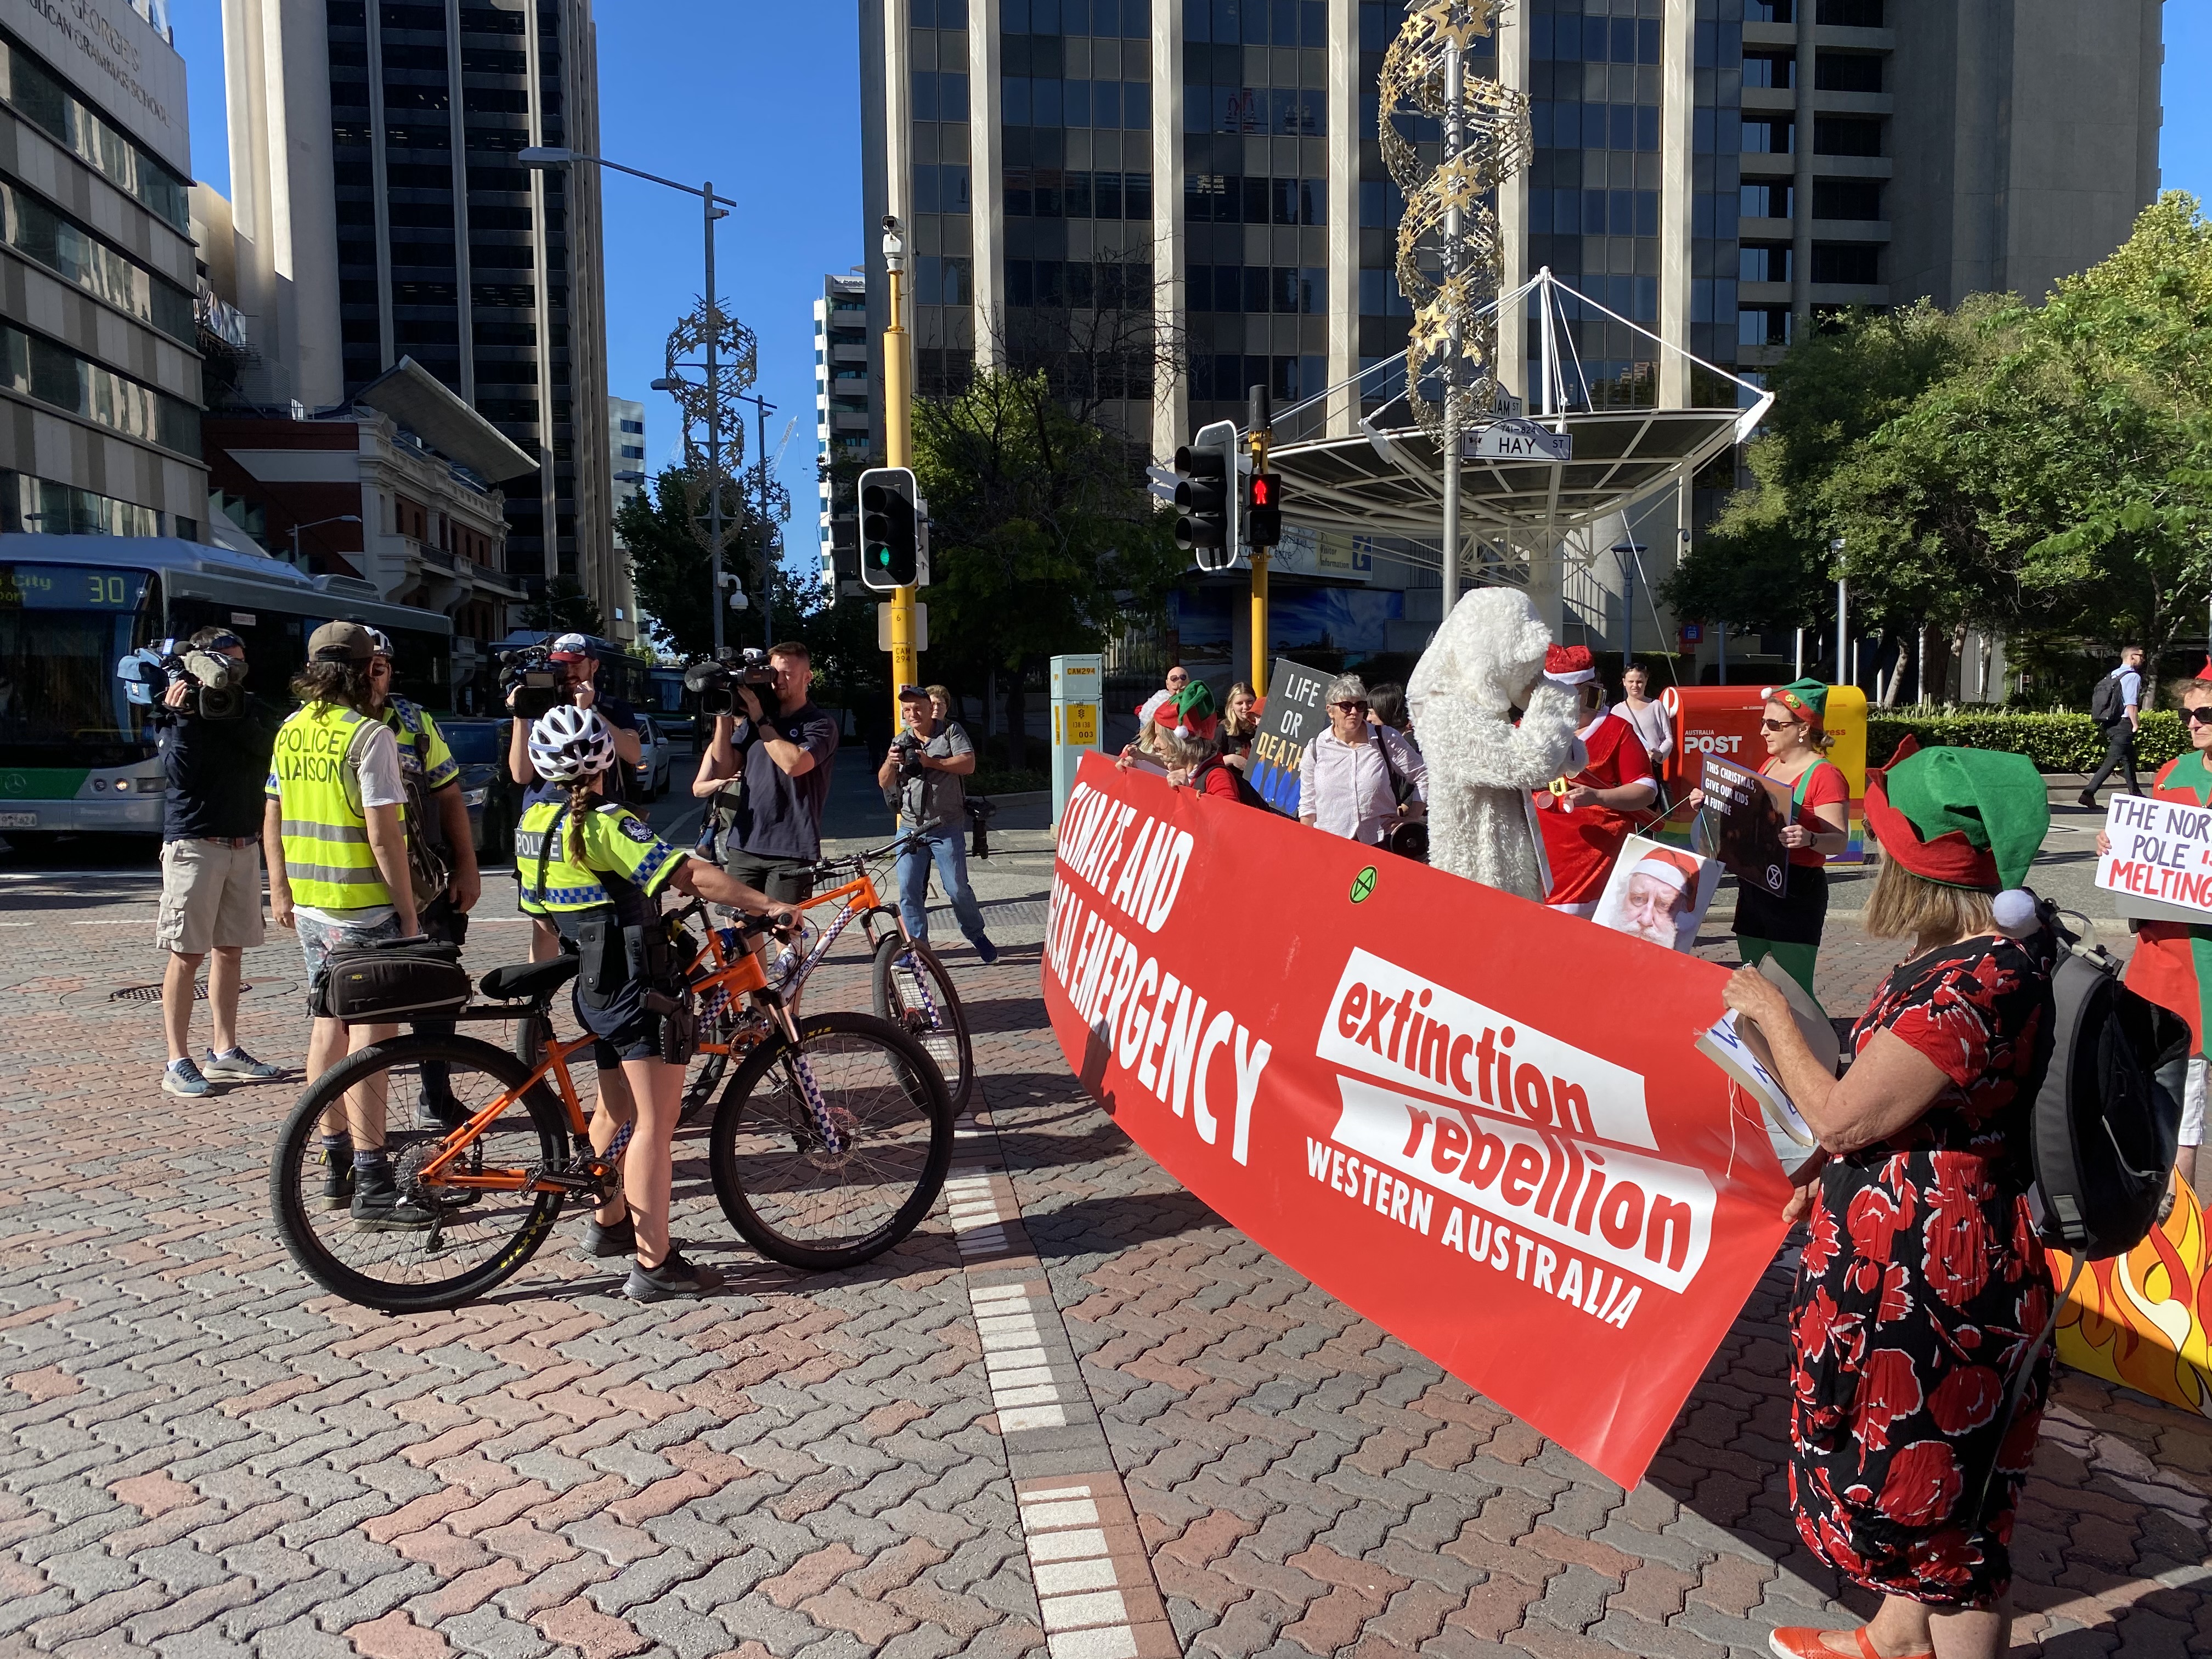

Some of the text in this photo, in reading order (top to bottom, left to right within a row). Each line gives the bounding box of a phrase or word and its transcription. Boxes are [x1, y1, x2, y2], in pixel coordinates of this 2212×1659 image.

[1513, 402, 1519, 411] ST
[1499, 437, 1564, 454] HAY ST
[10, 574, 125, 603] City 30
[1284, 674, 1321, 708] LIFE
[1280, 710, 1303, 738] OR
[278, 727, 347, 755] POLICE
[1684, 736, 1742, 754] POST
[276, 755, 343, 785] LIAISON
[1706, 760, 1757, 793] THIS CHRISTMAS,
[1703, 794, 1733, 816] A FUTURE
[1705, 777, 1749, 806] GIVE OUR KIDS
[2114, 799, 2212, 843] THE NOR
[1058, 781, 1194, 933] CLIMATE AND
[2131, 834, 2191, 869] POLE
[2109, 859, 2212, 907] MELTING
[797, 949, 821, 977] Police
[1068, 910, 1272, 1166] EMERGENCY
[1338, 981, 1598, 1138] extinction
[1402, 1103, 1692, 1273] rebellion
[858, 1216, 895, 1244] ALEXRIMS
[1307, 1136, 1643, 1330] WESTERN AUSTRALIA
